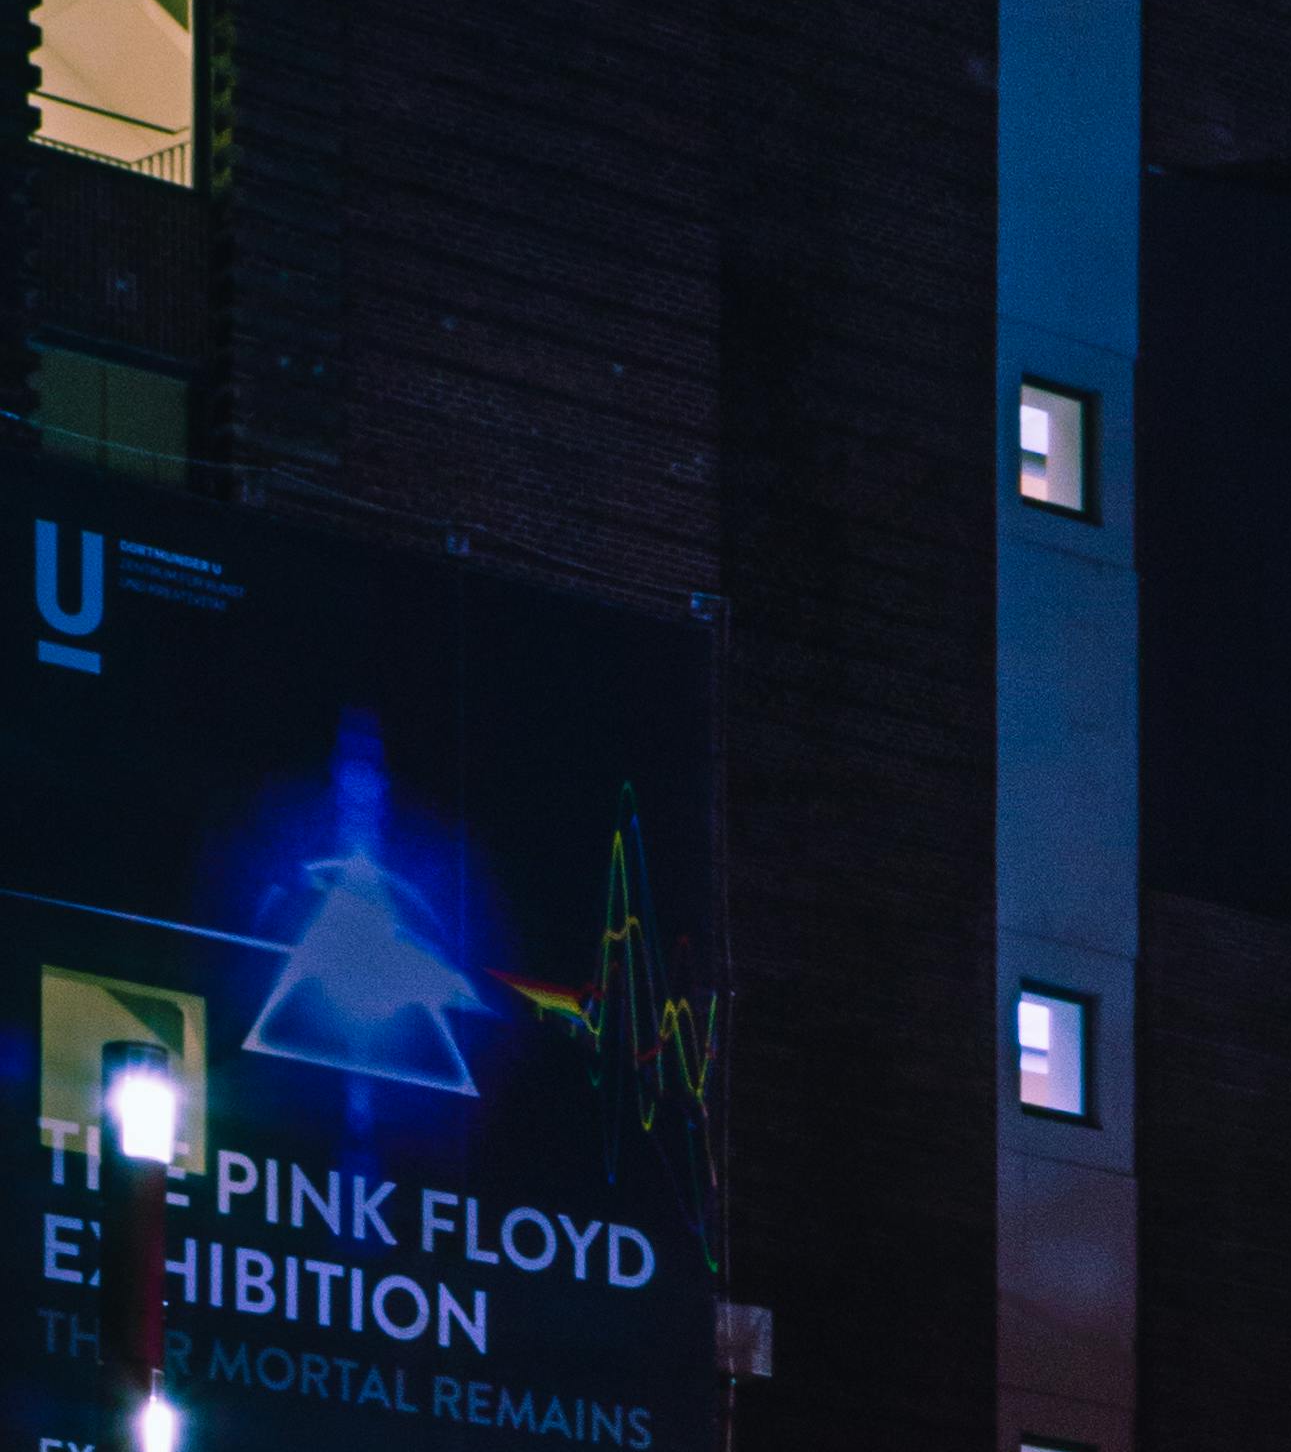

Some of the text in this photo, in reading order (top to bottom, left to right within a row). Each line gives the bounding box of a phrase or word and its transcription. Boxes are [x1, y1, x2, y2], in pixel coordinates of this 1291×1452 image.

[35, 517, 104, 637] U
[217, 1149, 398, 1247] PINK
[420, 1187, 656, 1290] FLOYD
[38, 1307, 653, 1451] THR MORTAL REMAINS
